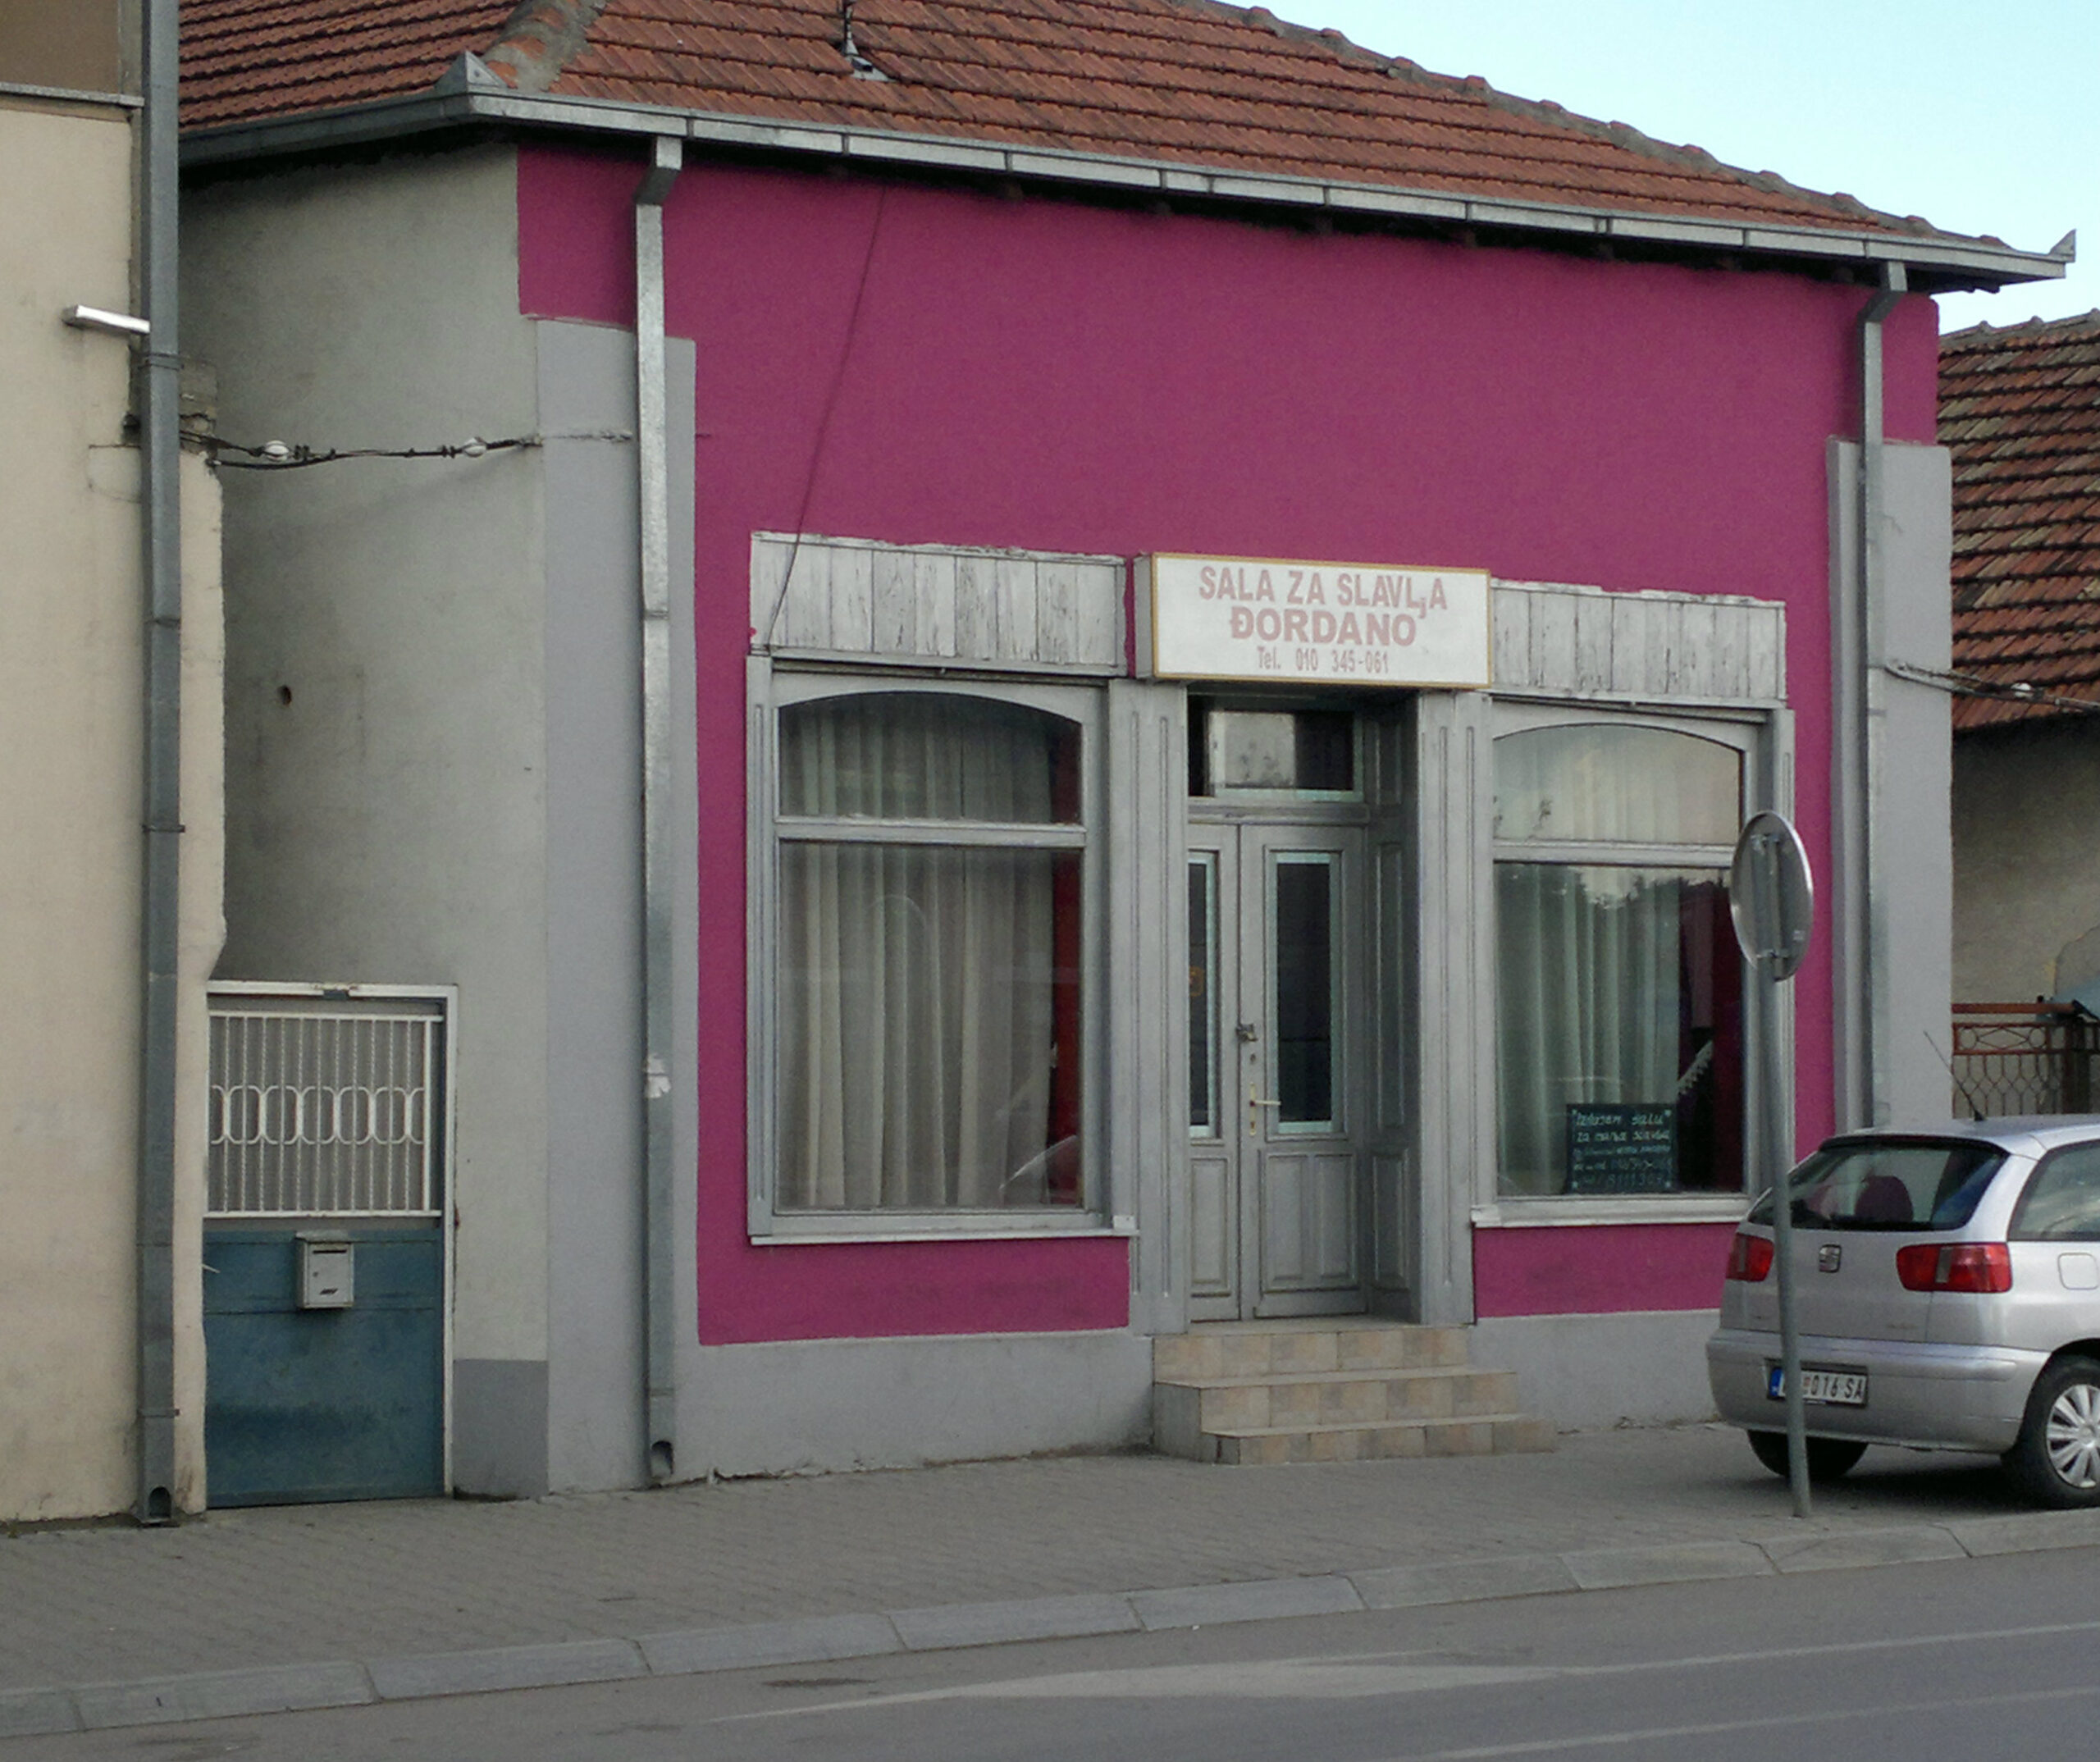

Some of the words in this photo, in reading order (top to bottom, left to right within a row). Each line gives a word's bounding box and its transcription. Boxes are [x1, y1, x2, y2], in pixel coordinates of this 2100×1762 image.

[1198, 566, 1276, 602] SALA
[1287, 570, 1326, 605] ZA
[1230, 607, 1417, 646] ĐORDANO
[1257, 646, 1281, 670] Tel.
[1295, 647, 1319, 672] 010
[1331, 649, 1389, 673] 345-061
